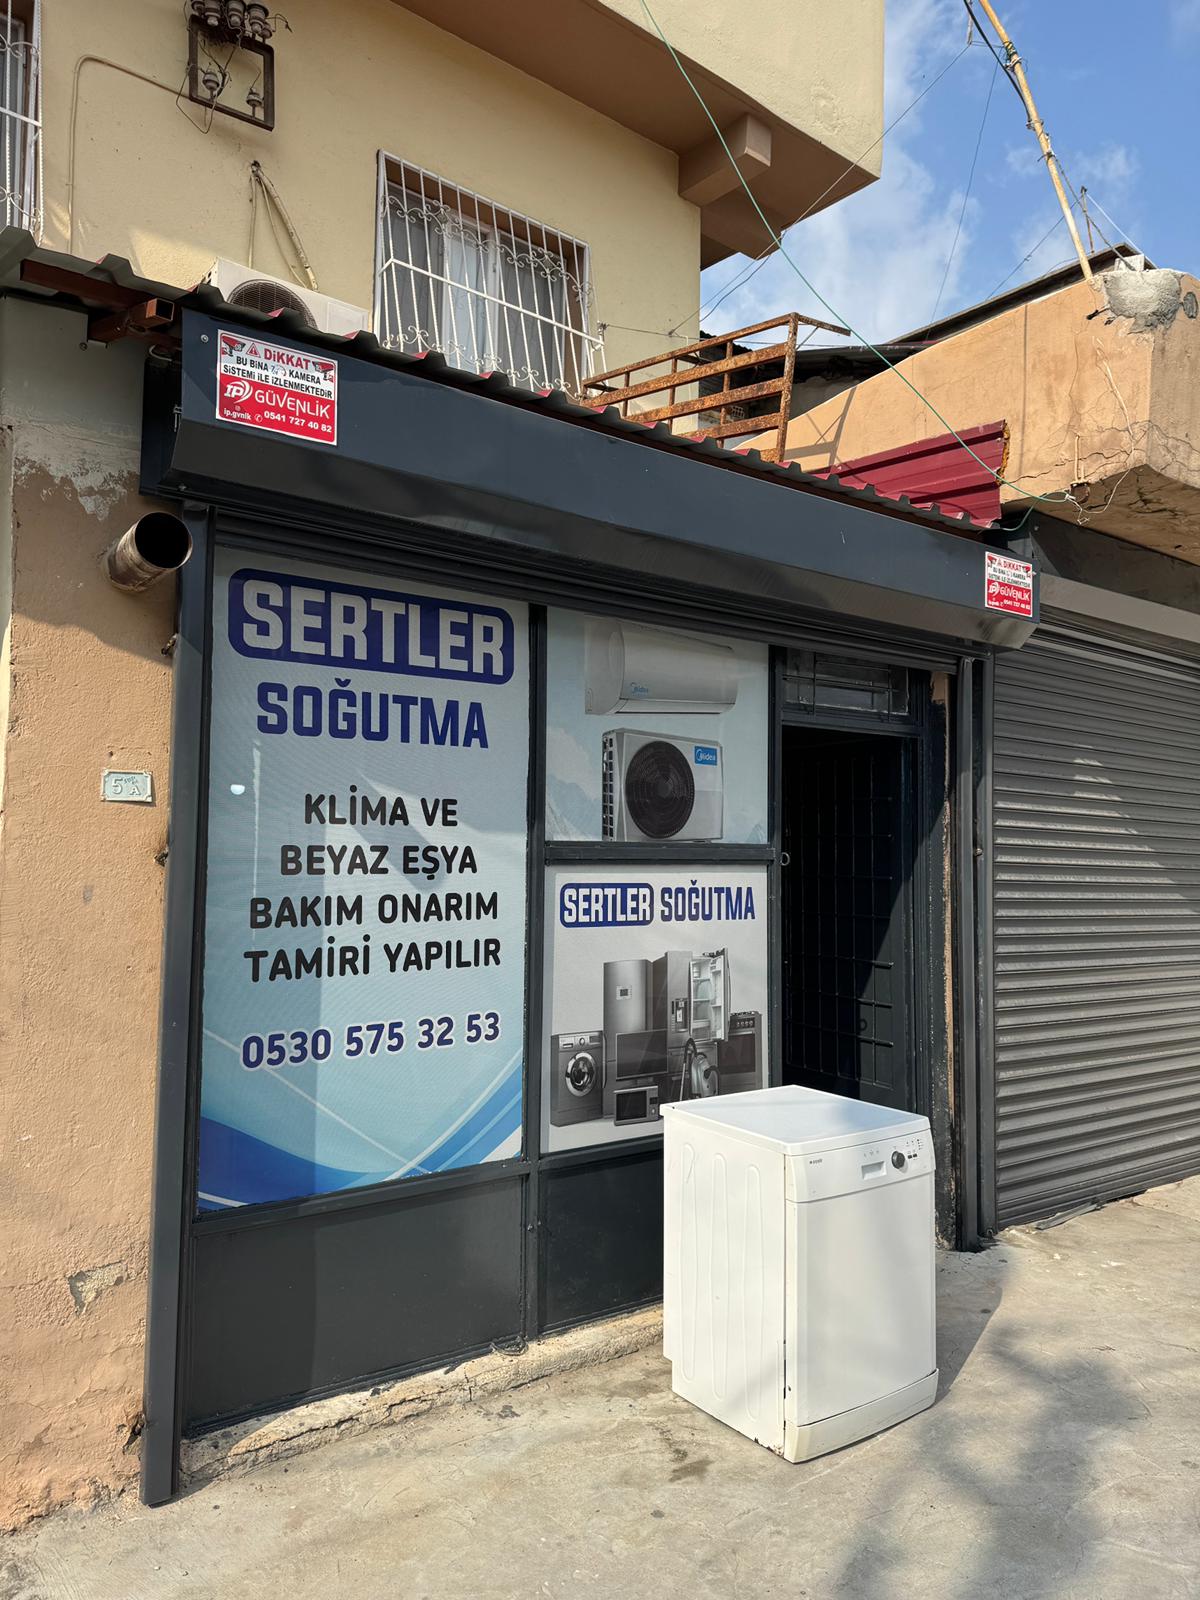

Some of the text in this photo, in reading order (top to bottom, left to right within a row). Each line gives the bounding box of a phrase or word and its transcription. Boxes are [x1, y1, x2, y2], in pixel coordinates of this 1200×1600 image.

[236, 356, 248, 366] BU
[289, 369, 321, 385] KAMERA
[264, 410, 286, 422] 0541
[289, 416, 305, 427] 727
[307, 421, 319, 430] 40
[321, 423, 332, 433] 82
[242, 579, 504, 676] SERTLER
[257, 677, 489, 749] SOĞUTMA
[112, 778, 124, 795] 5
[127, 784, 141, 796] A
[304, 785, 458, 827] KLİMA VE
[280, 845, 478, 881] BEYAZ EŞYA
[249, 892, 498, 929] BAKIM ONARIM
[563, 879, 756, 924] SERTLER SOĞUTMA
[243, 934, 501, 983] TAMİRİ YAPILIR
[242, 1012, 500, 1069] 0530 575 32 53
